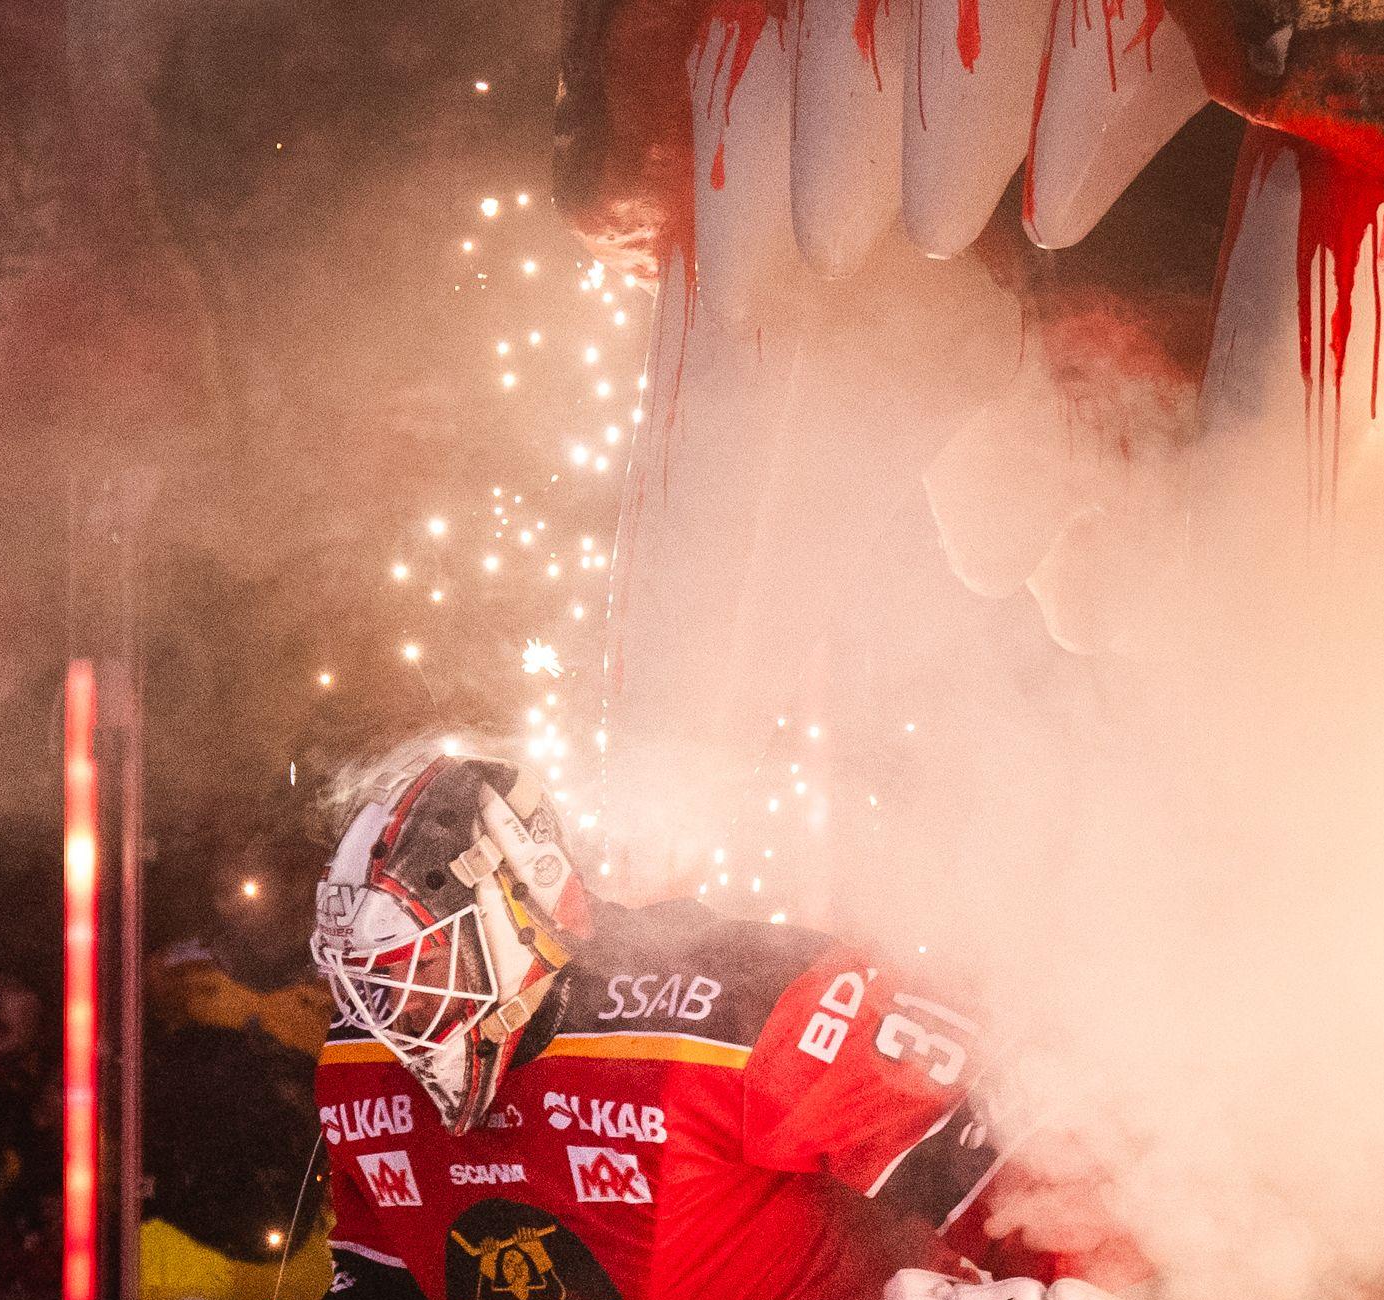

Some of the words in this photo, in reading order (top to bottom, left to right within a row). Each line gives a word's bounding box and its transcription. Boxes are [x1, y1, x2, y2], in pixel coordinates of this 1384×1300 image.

[598, 974, 722, 1020] SSAB
[797, 967, 879, 1065] BD
[875, 992, 983, 1086] 31
[340, 1094, 413, 1143] LKAB
[569, 1095, 668, 1145] LKAB
[370, 1156, 411, 1202] MAX
[449, 1163, 528, 1186] SCANIA
[577, 1150, 643, 1199] MAX
